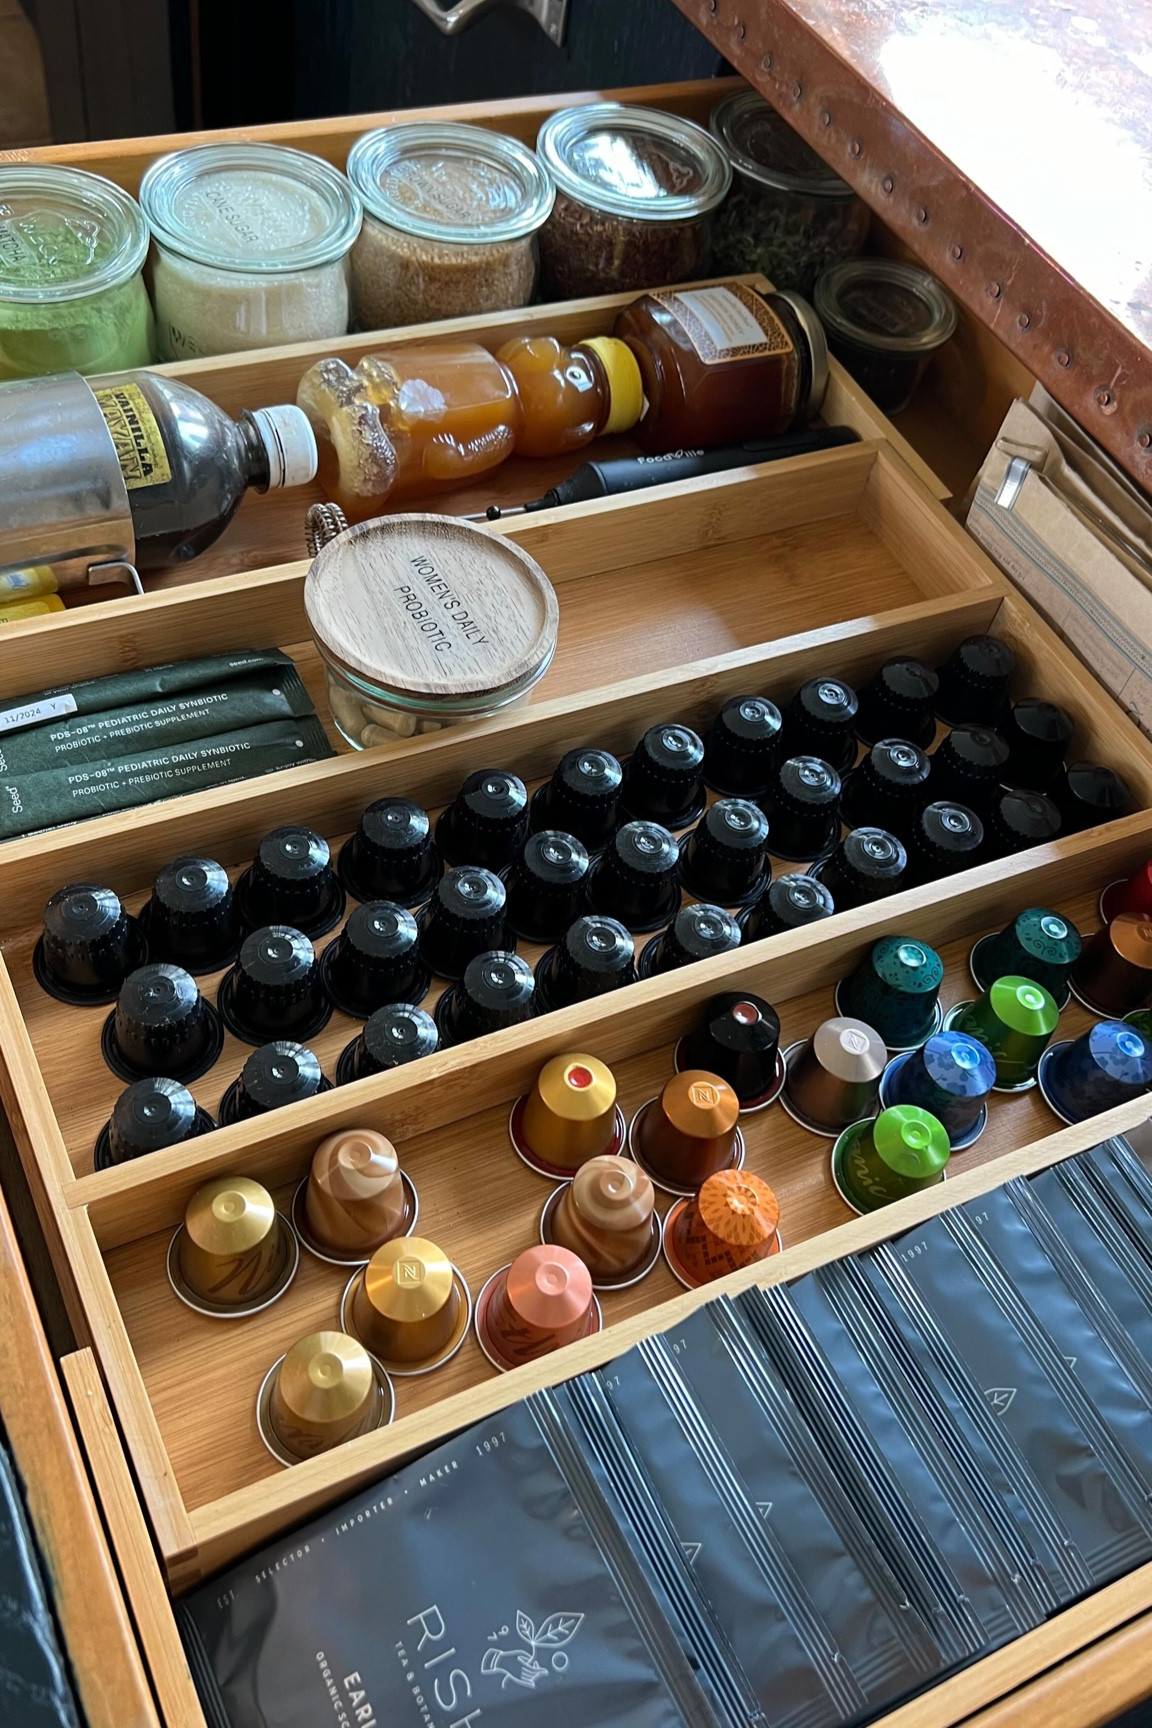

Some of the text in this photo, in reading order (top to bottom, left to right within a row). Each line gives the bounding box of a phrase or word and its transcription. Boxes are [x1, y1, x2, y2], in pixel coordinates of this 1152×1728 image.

[205, 190, 230, 216] CANE
[225, 211, 259, 243] SUGAR
[114, 392, 154, 477] VAINILLA
[393, 585, 452, 652] PROBIOTIC
[410, 555, 489, 646] WOMEN'S DAILY
[5, 707, 42, 724] 11/2024
[55, 734, 101, 753] PROBIOTIC
[109, 720, 154, 738] PREBIOTIC
[154, 708, 210, 728] SUPPLEMENT
[98, 711, 149, 730] PEDIATRIC
[150, 704, 177, 718] DAILY
[179, 692, 229, 711] SYNBIOTIC
[72, 780, 120, 798] PROBIOTIC
[128, 768, 174, 786] PREBIOTIC
[174, 758, 232, 776] SUPPLEMENT
[118, 755, 170, 774] PEDIATRIC
[171, 750, 199, 763] DAILY
[200, 741, 251, 758] SYNBIOTIC
[901, 1241, 929, 1262] 1997
[254, 1544, 311, 1584] SELECTOR
[335, 1496, 394, 1536] IMPORTER
[419, 1460, 458, 1487] MAKER
[475, 1431, 507, 1457] 1997
[395, 1640, 409, 1668] TEA
[316, 1651, 343, 1712] ORGANIC
